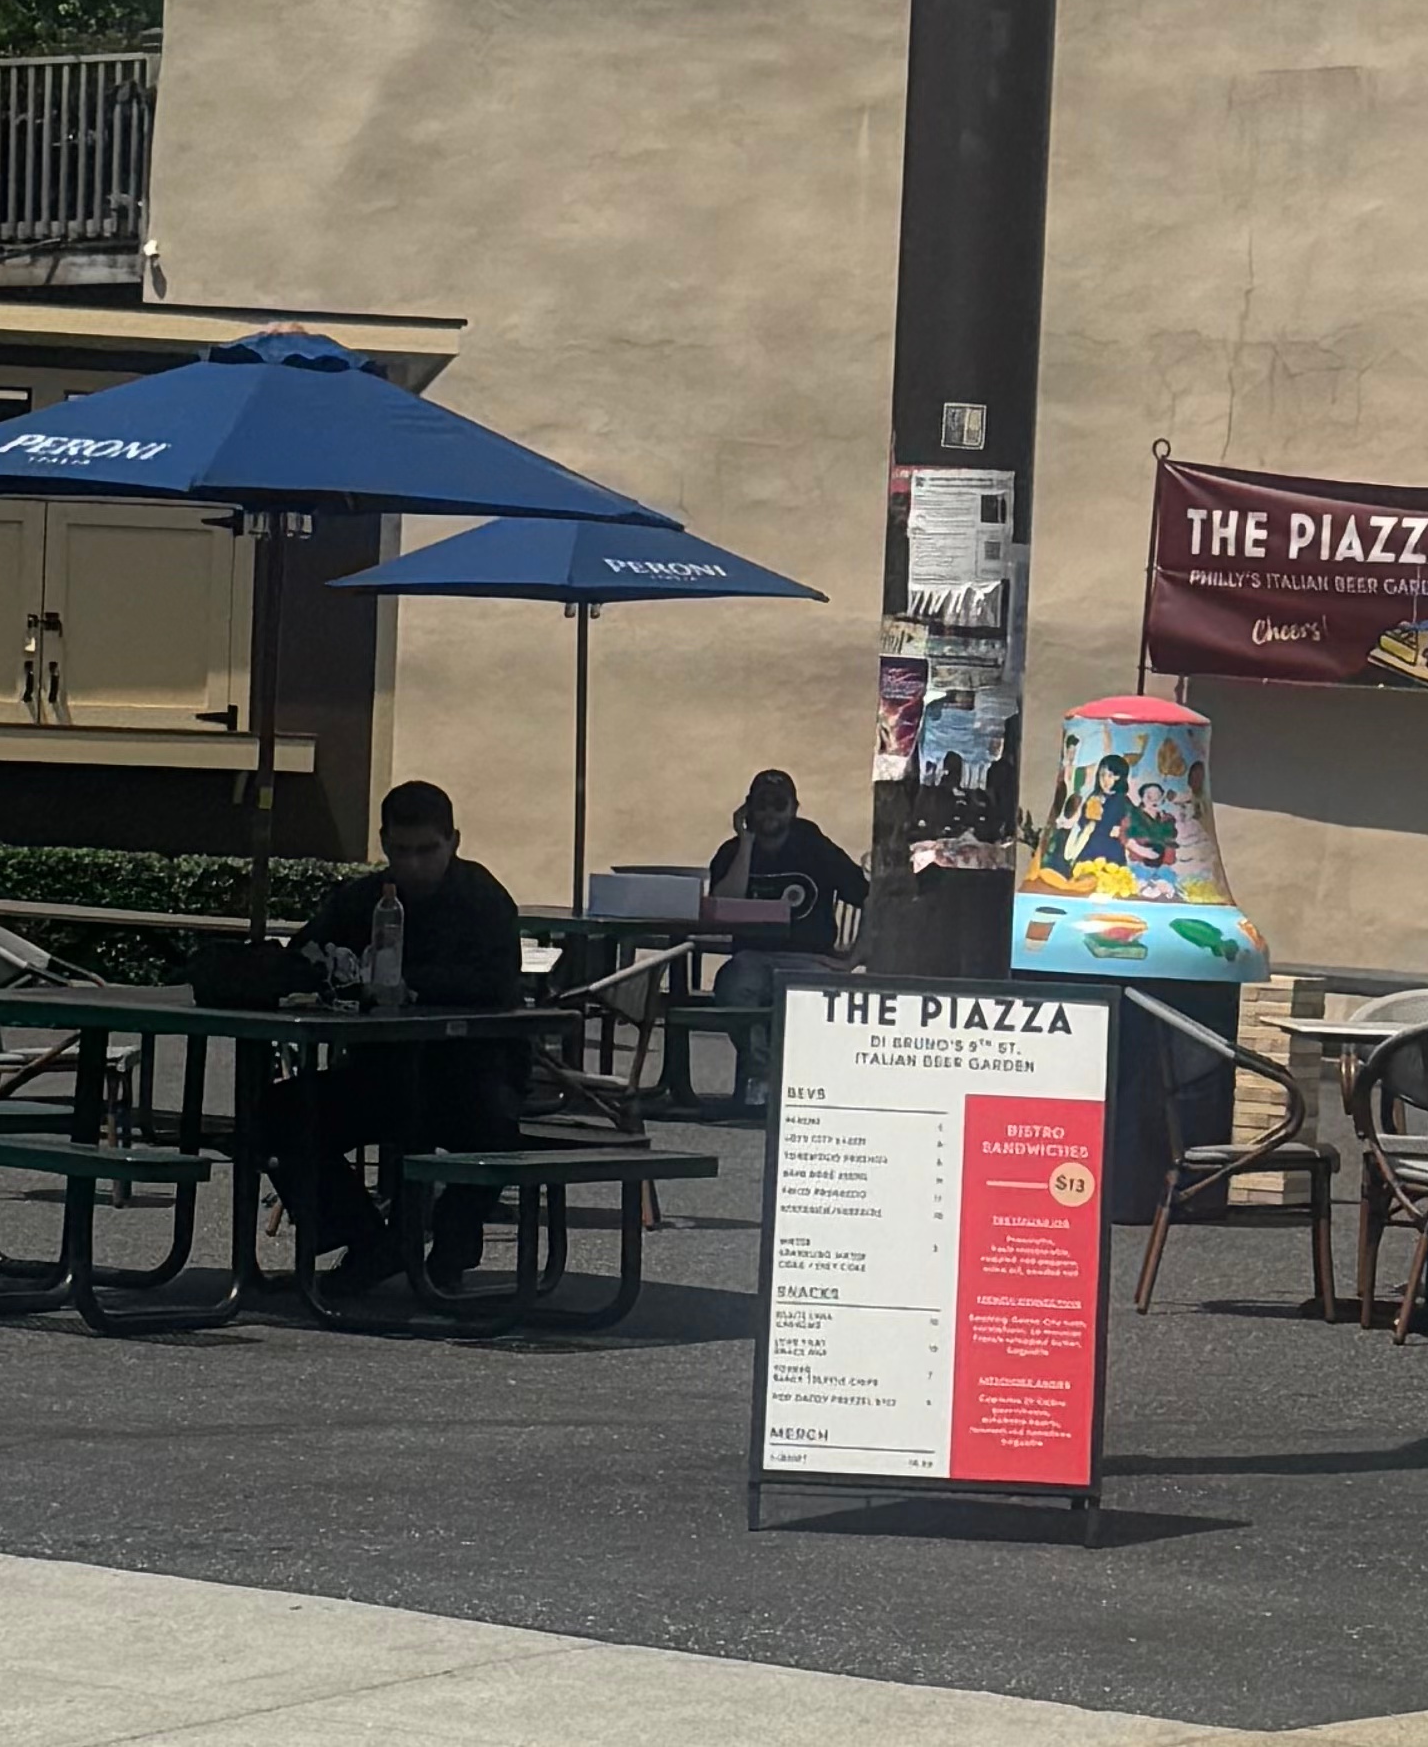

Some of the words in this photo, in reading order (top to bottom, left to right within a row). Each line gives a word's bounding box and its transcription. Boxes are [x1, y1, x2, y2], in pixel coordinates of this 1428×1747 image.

[1187, 508, 1268, 558] THE
[602, 557, 728, 577] PERONI
[1189, 569, 1262, 589] PHILLY'S
[1267, 573, 1329, 591] ITALIAN
[1335, 576, 1379, 594] BEER
[822, 990, 897, 1027] THE
[921, 995, 1073, 1035] PIAZZA
[870, 1035, 887, 1049] DI
[892, 1037, 965, 1052] BRUNO'S
[854, 1051, 918, 1067] ITALIAN
[923, 1055, 963, 1069] BEER
[968, 1057, 1036, 1073] GARDEN
[786, 1087, 827, 1100] BEVS
[1007, 1124, 1066, 1139] BISTRO
[982, 1140, 1090, 1159] SANDWICHES
[777, 1286, 840, 1300] SNACKS
[769, 1427, 829, 1441] MERCH
